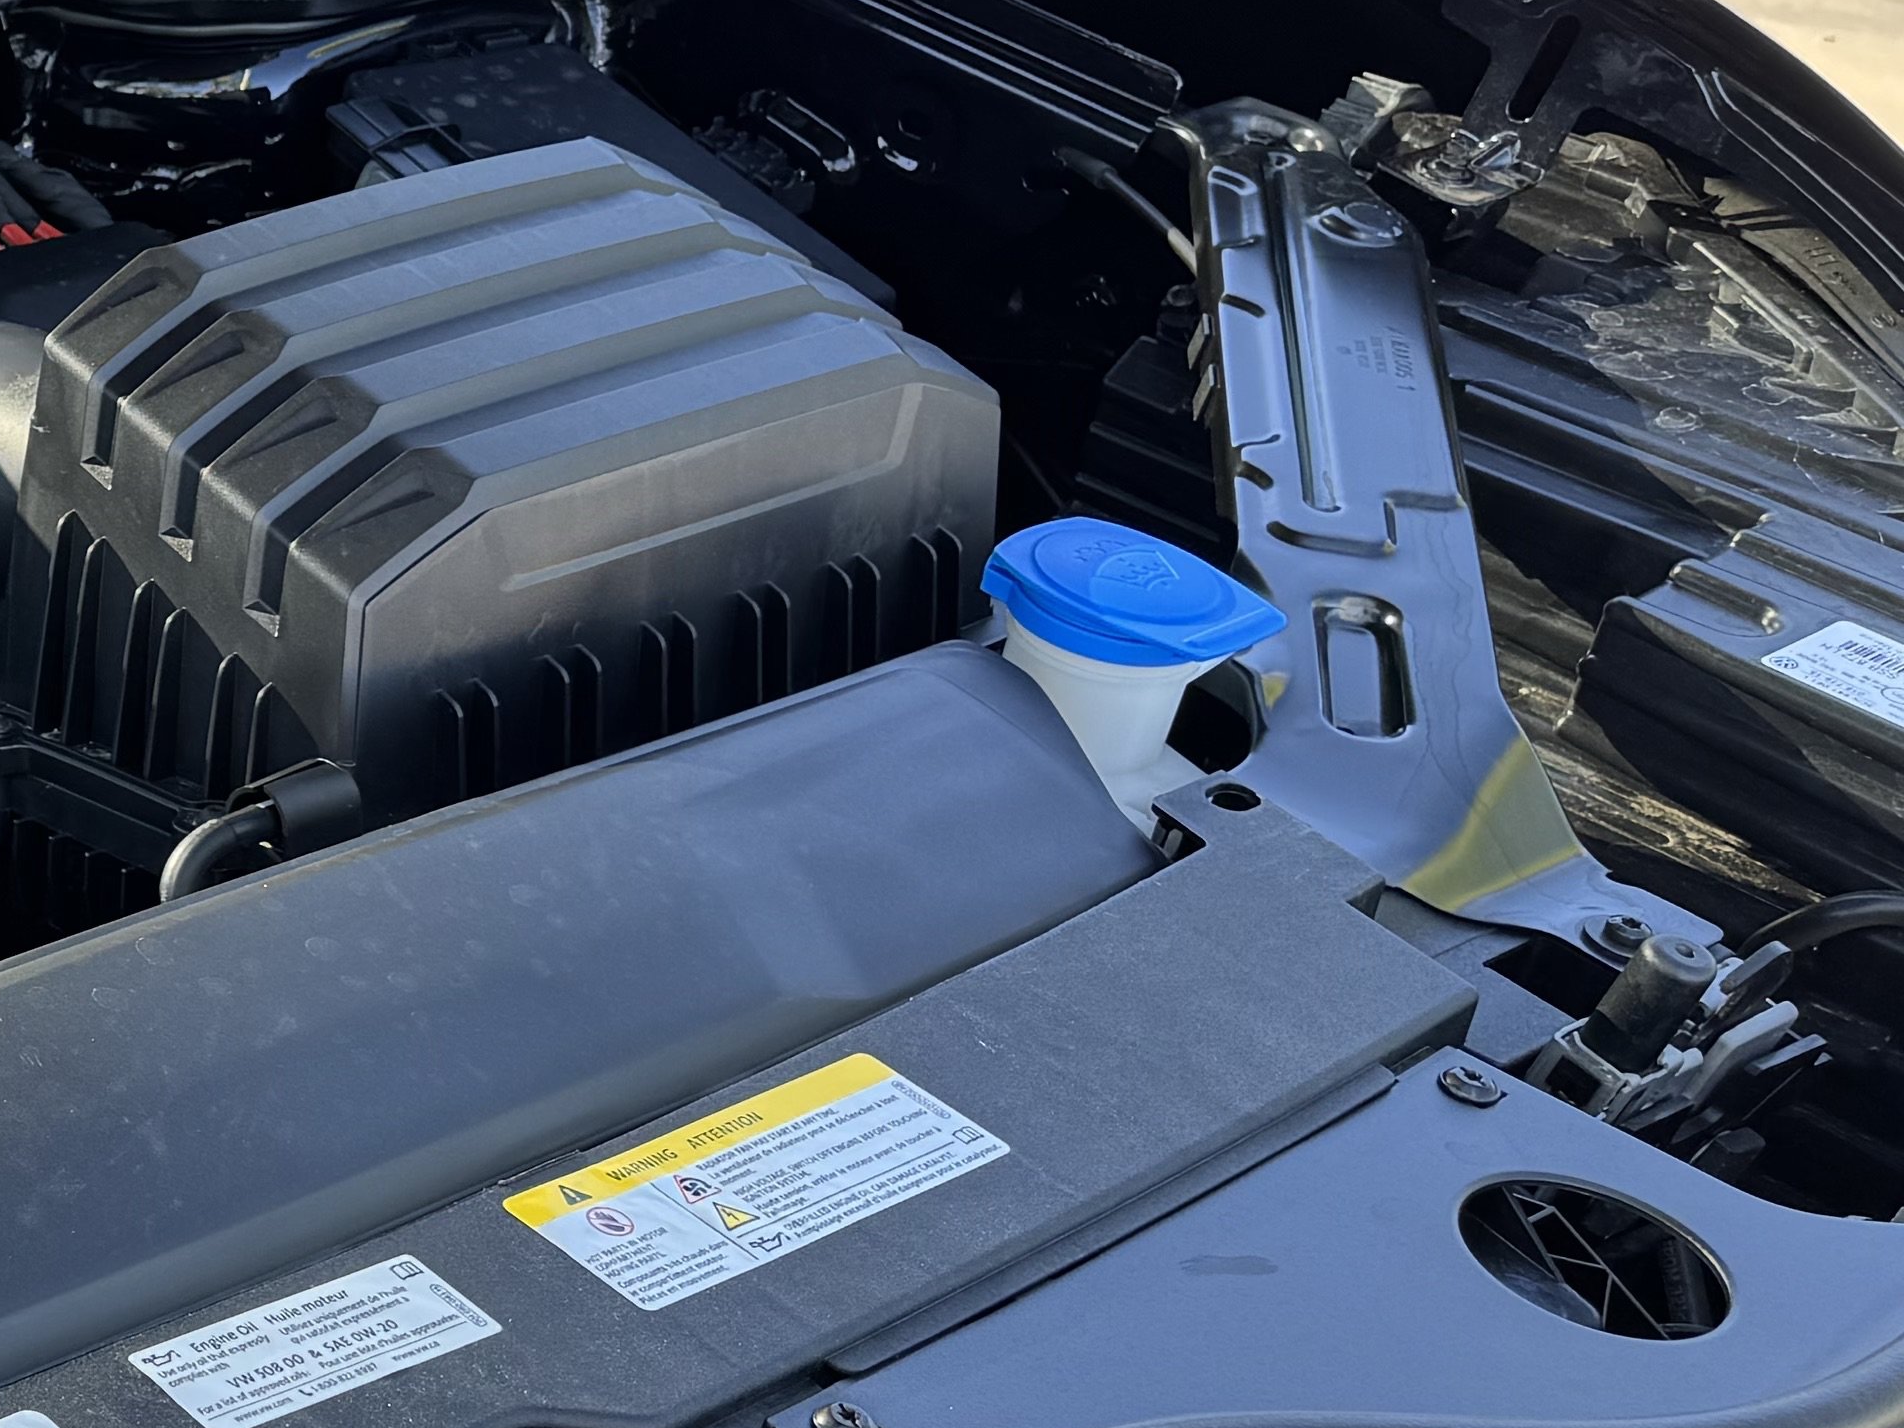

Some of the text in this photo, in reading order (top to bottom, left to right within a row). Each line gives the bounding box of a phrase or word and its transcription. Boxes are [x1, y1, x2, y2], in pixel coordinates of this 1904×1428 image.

[605, 1111, 763, 1180] WARNING ATTENTION
[188, 1289, 348, 1352] Engine Oil Huile moteur
[225, 1319, 398, 1388] VW 508 00 & SAE 0W-20
